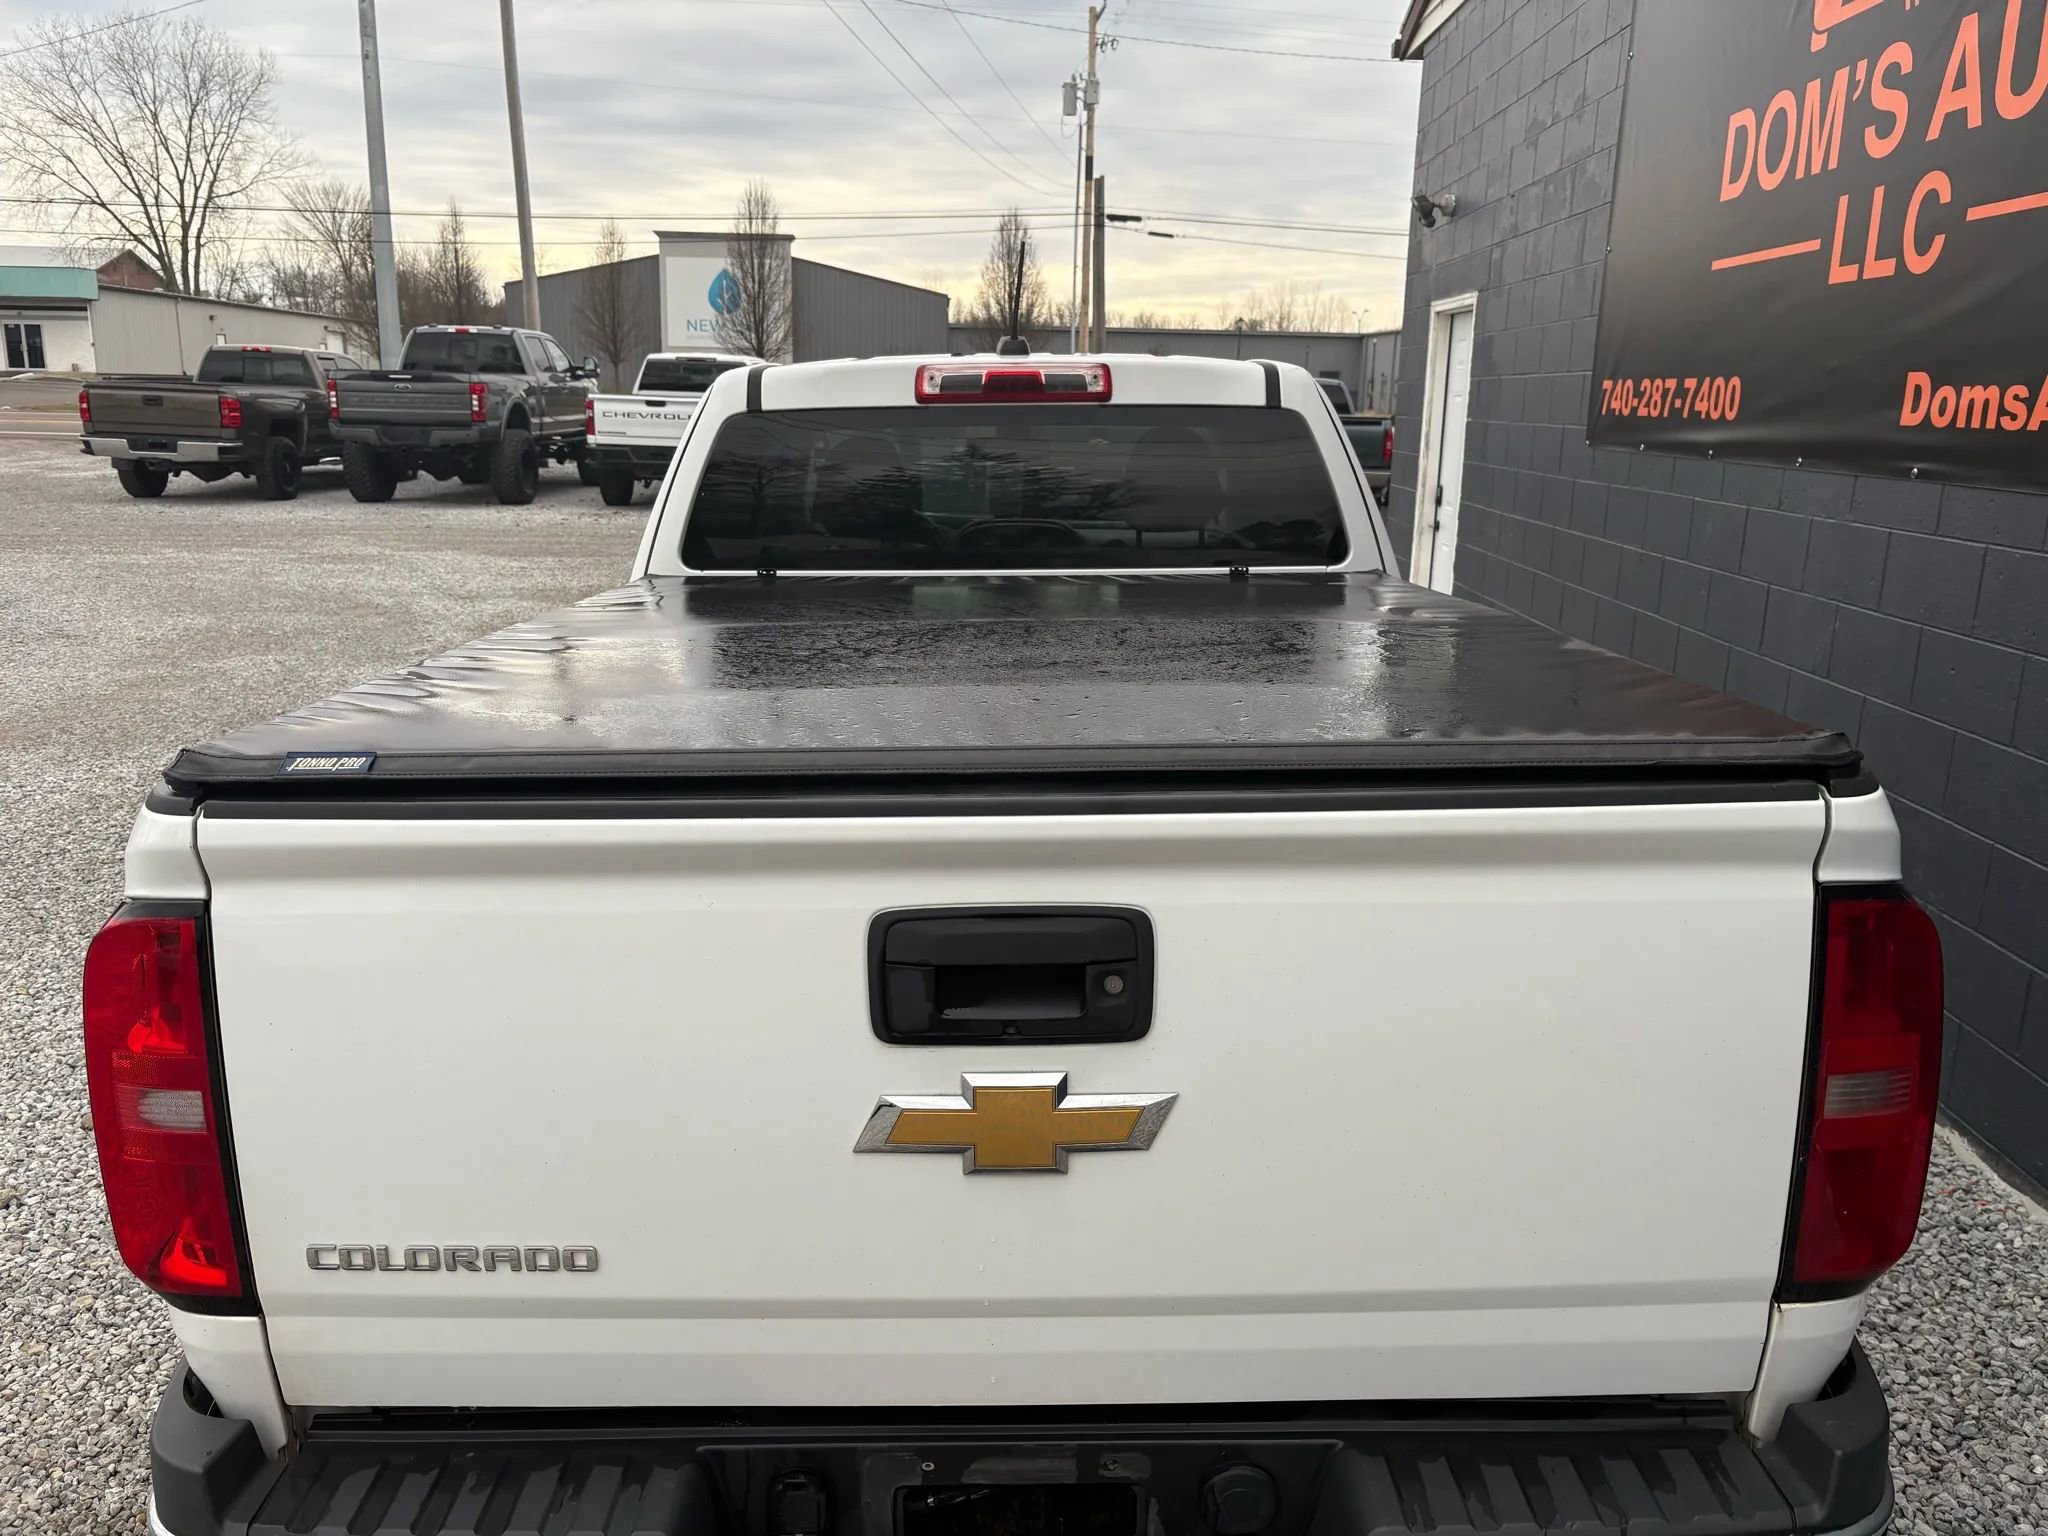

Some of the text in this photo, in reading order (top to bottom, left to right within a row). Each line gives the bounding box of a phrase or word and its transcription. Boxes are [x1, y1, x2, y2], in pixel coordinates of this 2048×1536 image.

[1720, 41, 1913, 202] DOM'S
[1828, 170, 1952, 285] LLC
[1601, 376, 1742, 421] 740-287-7400
[286, 757, 367, 771] TONNO PRO
[306, 1243, 599, 1272] COLORADO
